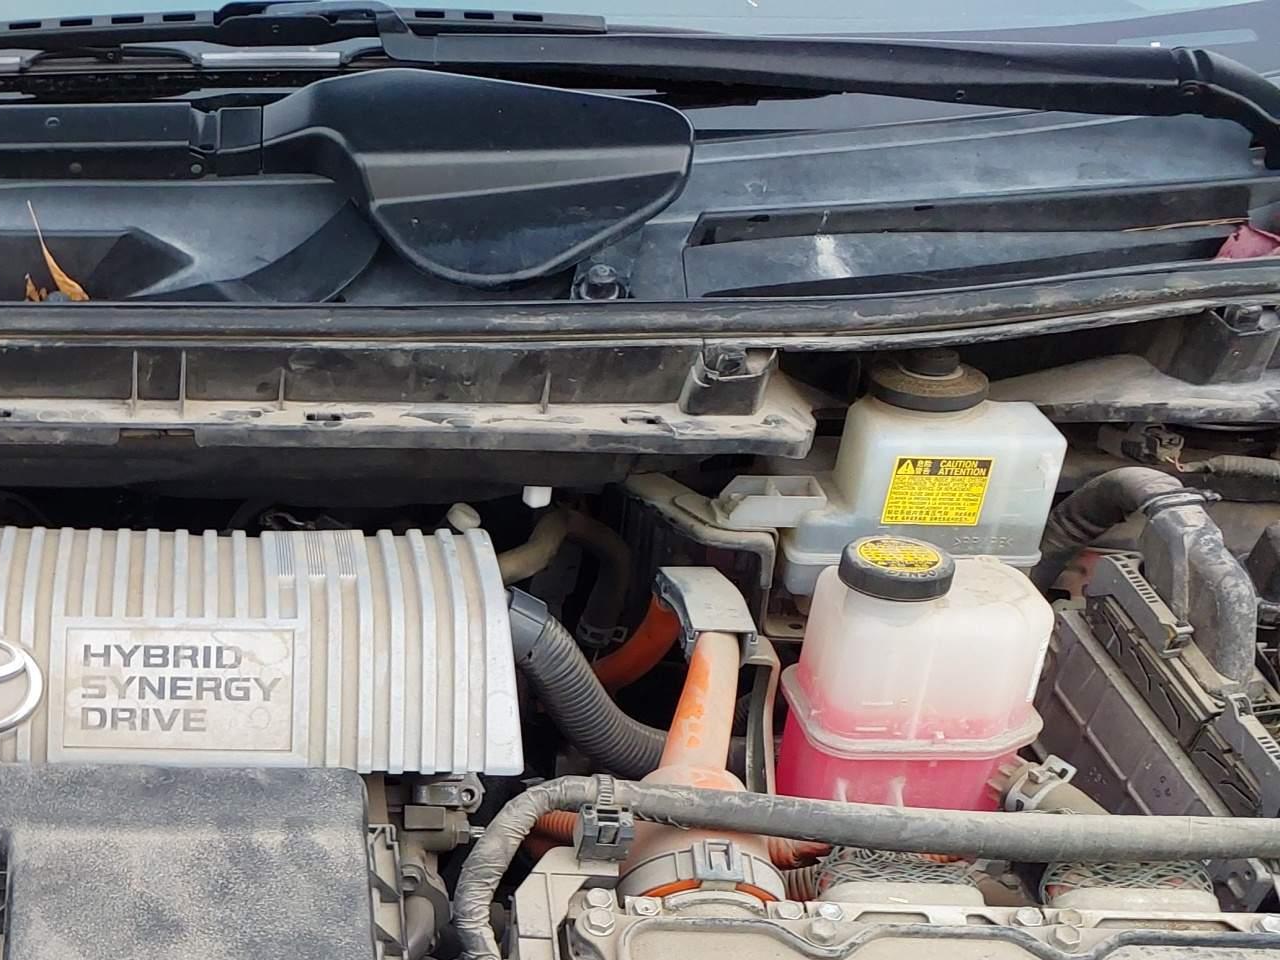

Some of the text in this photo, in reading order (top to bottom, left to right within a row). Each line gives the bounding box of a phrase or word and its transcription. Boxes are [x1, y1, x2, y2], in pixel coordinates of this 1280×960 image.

[940, 460, 978, 468] CAUTION
[83, 644, 242, 669] HYBRID
[81, 676, 282, 701] SYNERGY
[80, 707, 208, 732] DRIVE
